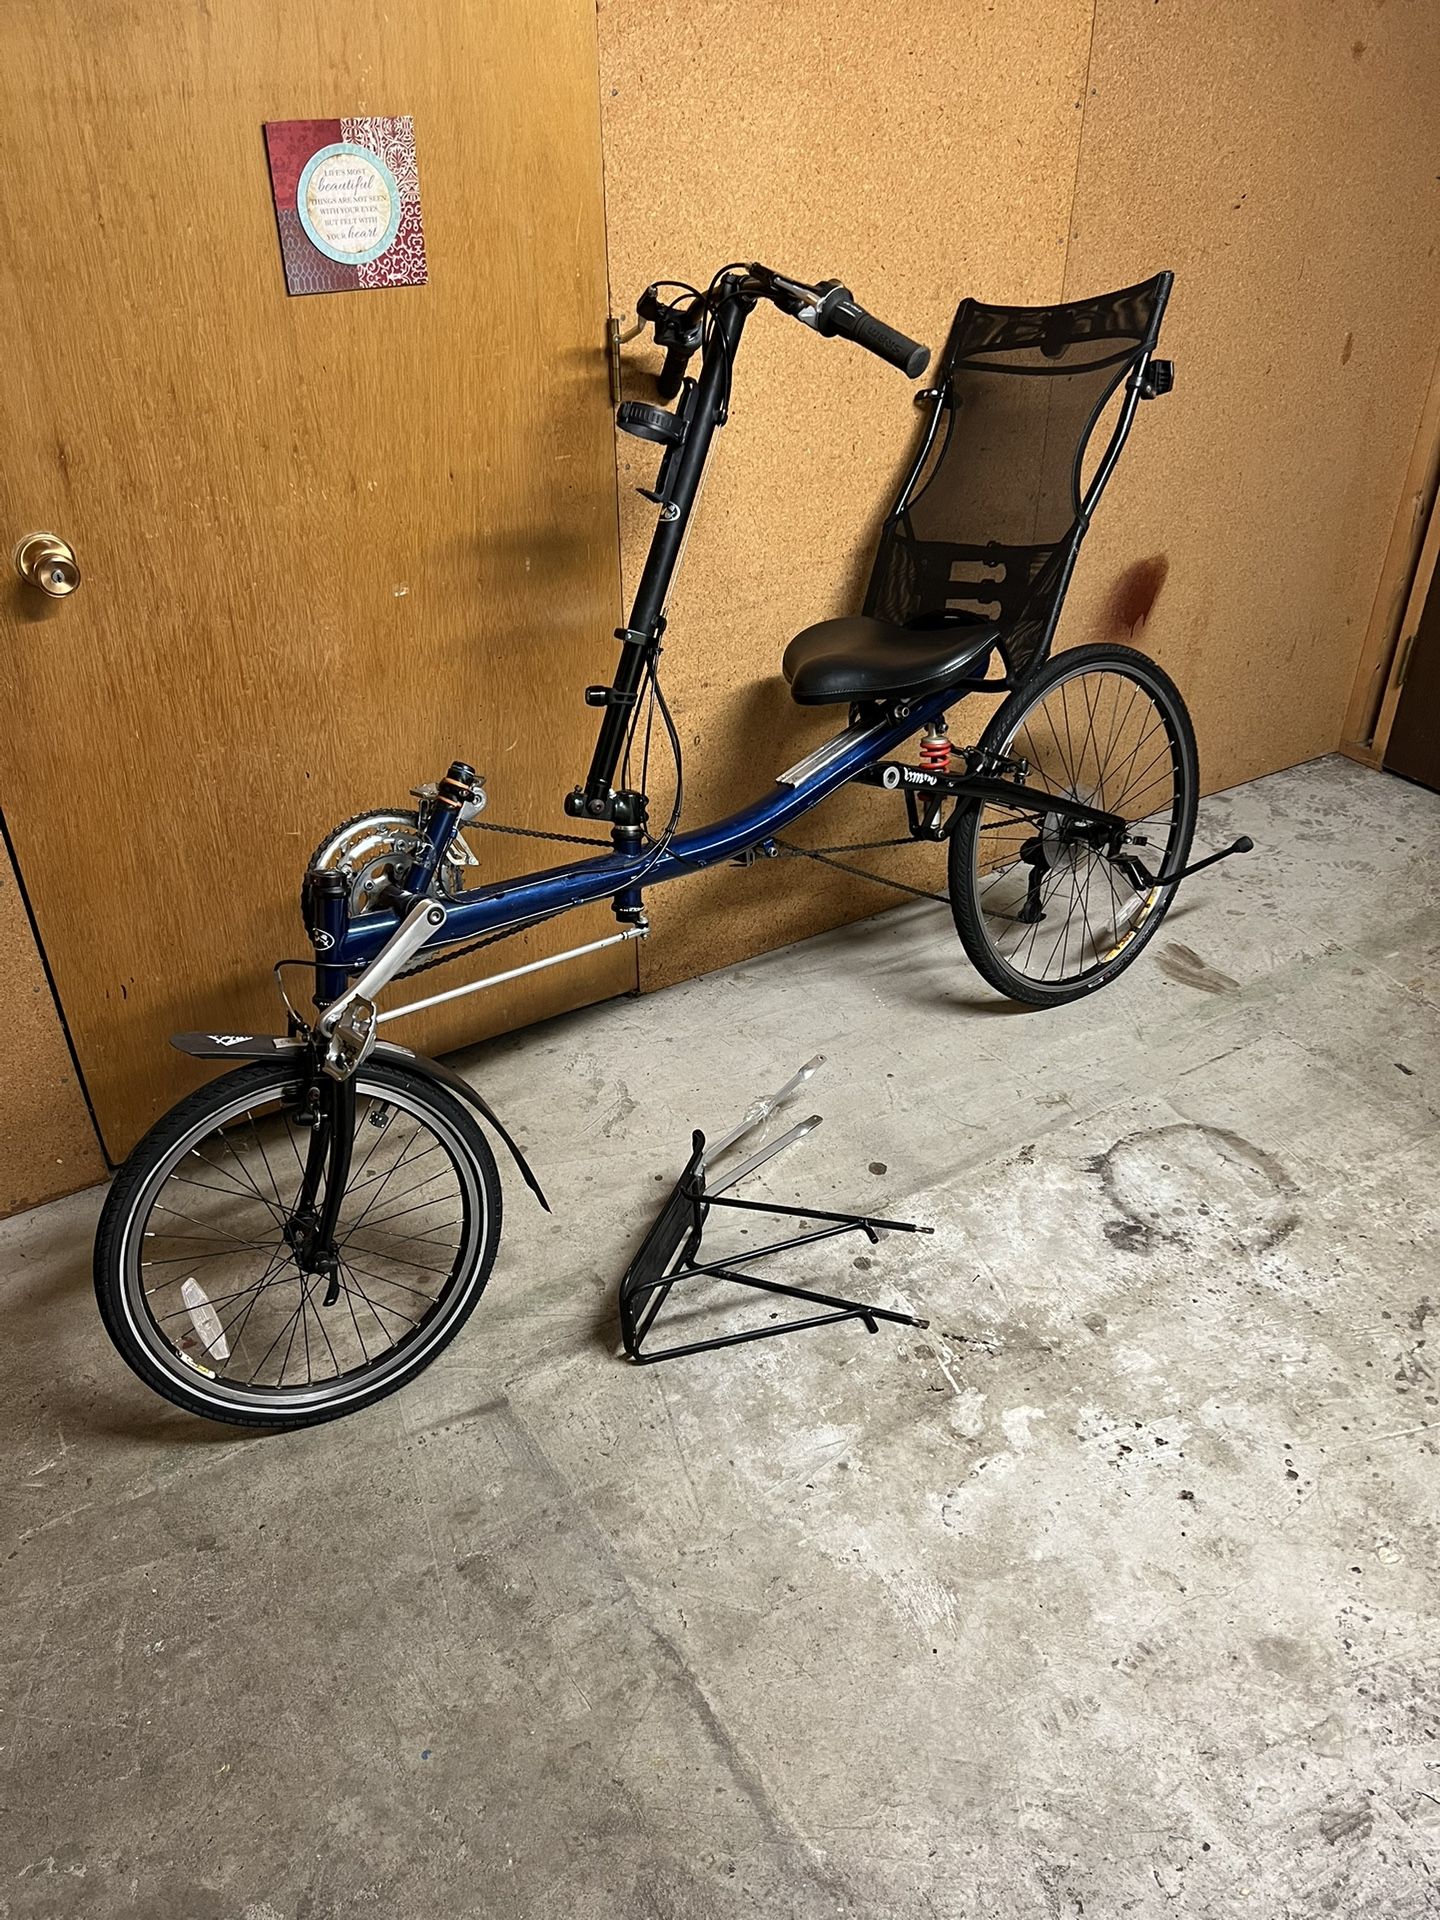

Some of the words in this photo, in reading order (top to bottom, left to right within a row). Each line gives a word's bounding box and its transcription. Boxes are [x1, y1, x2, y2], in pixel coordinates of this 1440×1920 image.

[318, 175, 375, 196] beautiful
[311, 198, 337, 206] THINGS
[320, 207, 339, 215] WITH
[339, 206, 360, 214] YOUR
[327, 233, 346, 241] YOUR
[348, 226, 378, 239] heart
